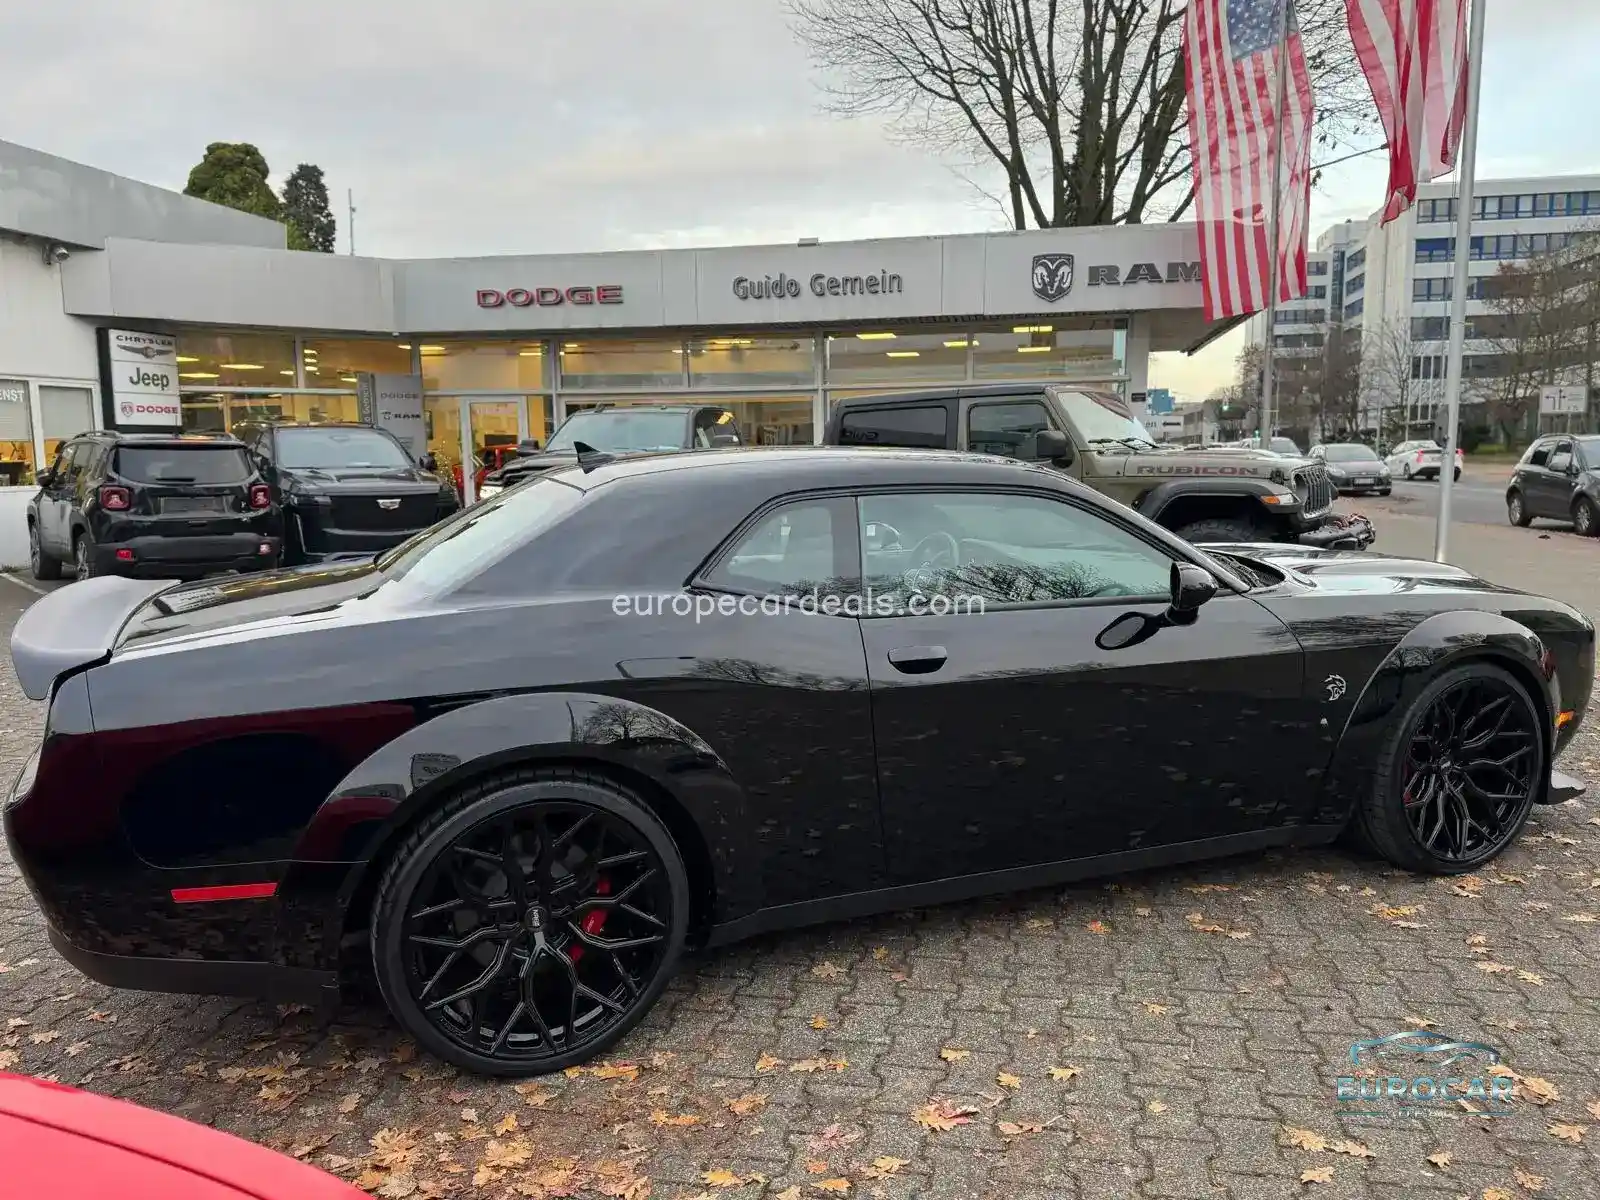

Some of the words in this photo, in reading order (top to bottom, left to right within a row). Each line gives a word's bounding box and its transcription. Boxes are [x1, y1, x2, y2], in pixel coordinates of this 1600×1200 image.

[733, 273, 801, 300] Guido
[809, 269, 903, 297] Gemein
[1087, 261, 1203, 286] RAM
[477, 286, 624, 308] DODGE
[116, 335, 173, 346] CHRYSLER
[129, 367, 170, 391] Jeep
[136, 405, 179, 414] DODGE
[1137, 466, 1258, 475] RUBICON
